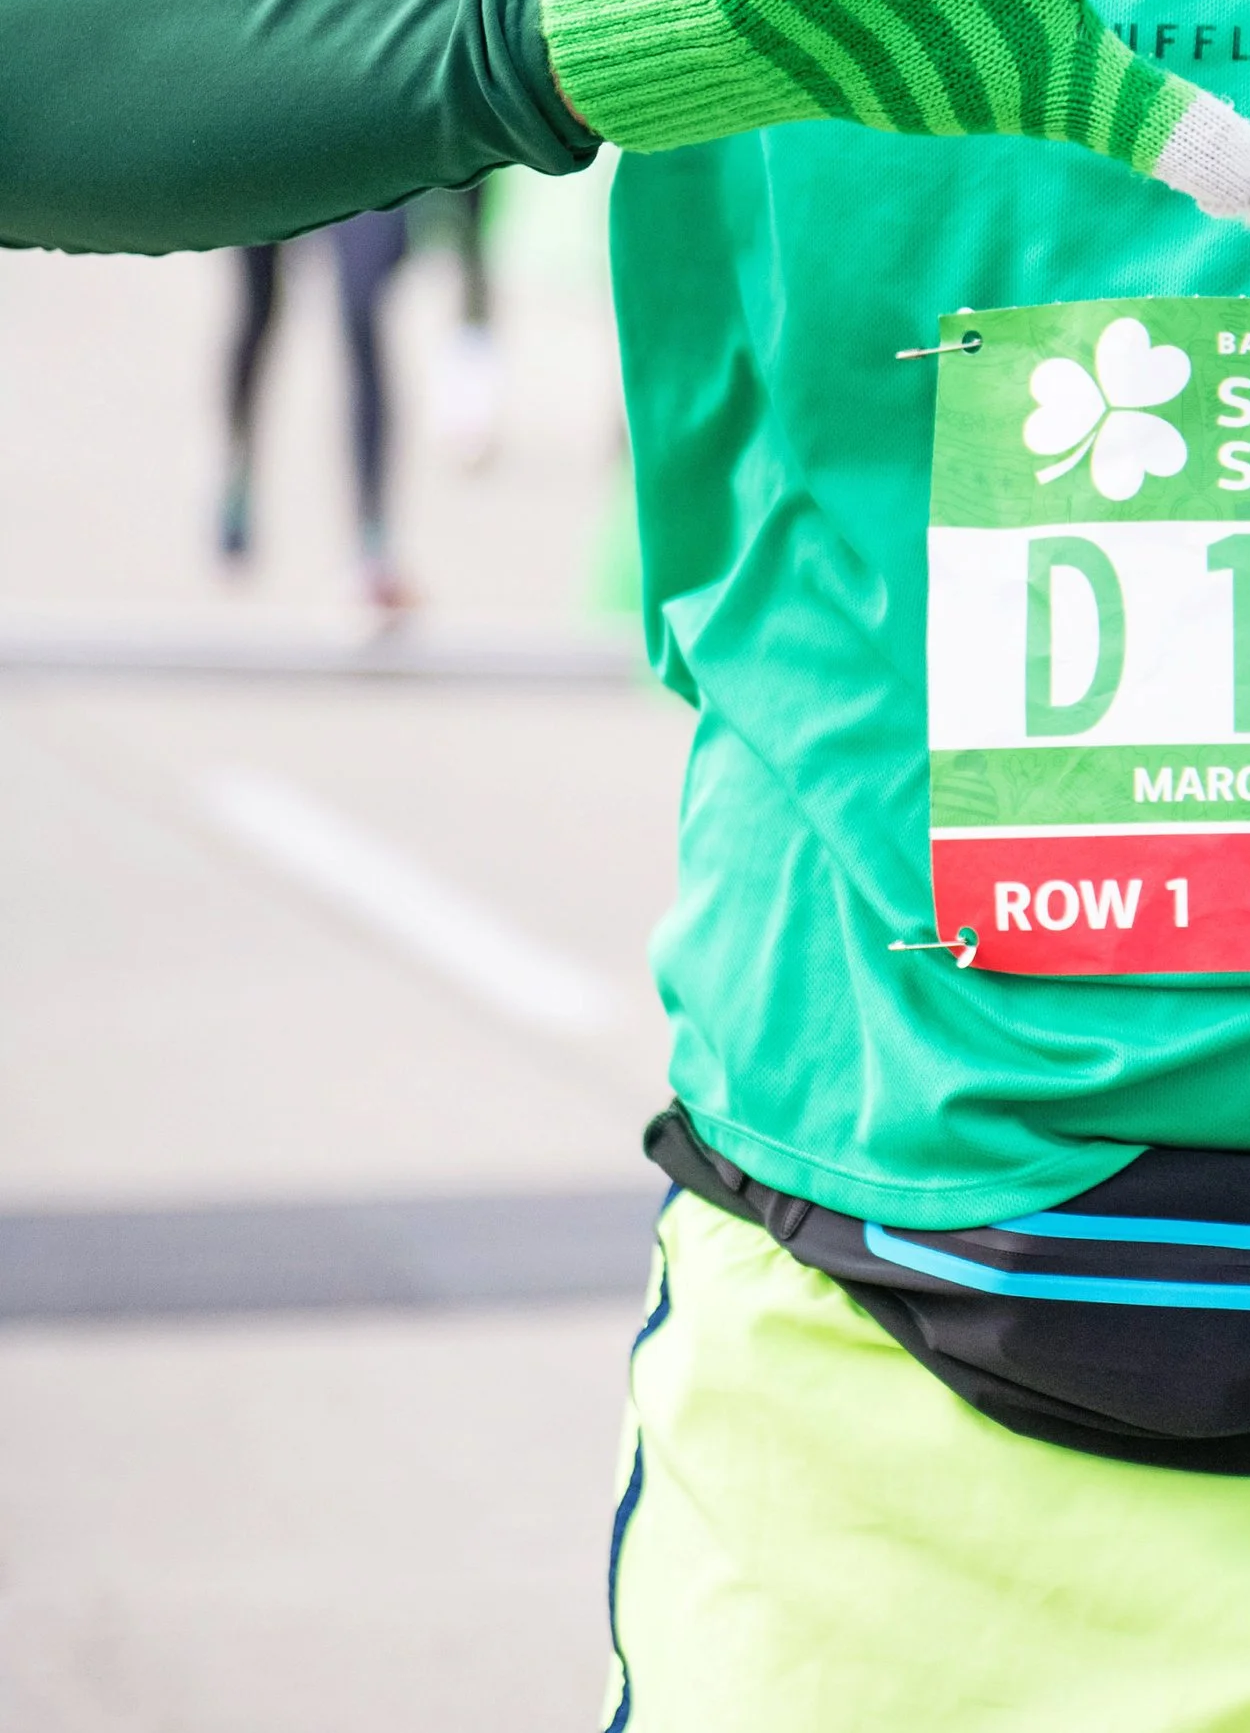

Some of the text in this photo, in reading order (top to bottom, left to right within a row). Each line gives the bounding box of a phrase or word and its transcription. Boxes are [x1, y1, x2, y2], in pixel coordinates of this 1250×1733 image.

[1026, 535, 1125, 737] D
[994, 878, 1189, 932] ROW 1
